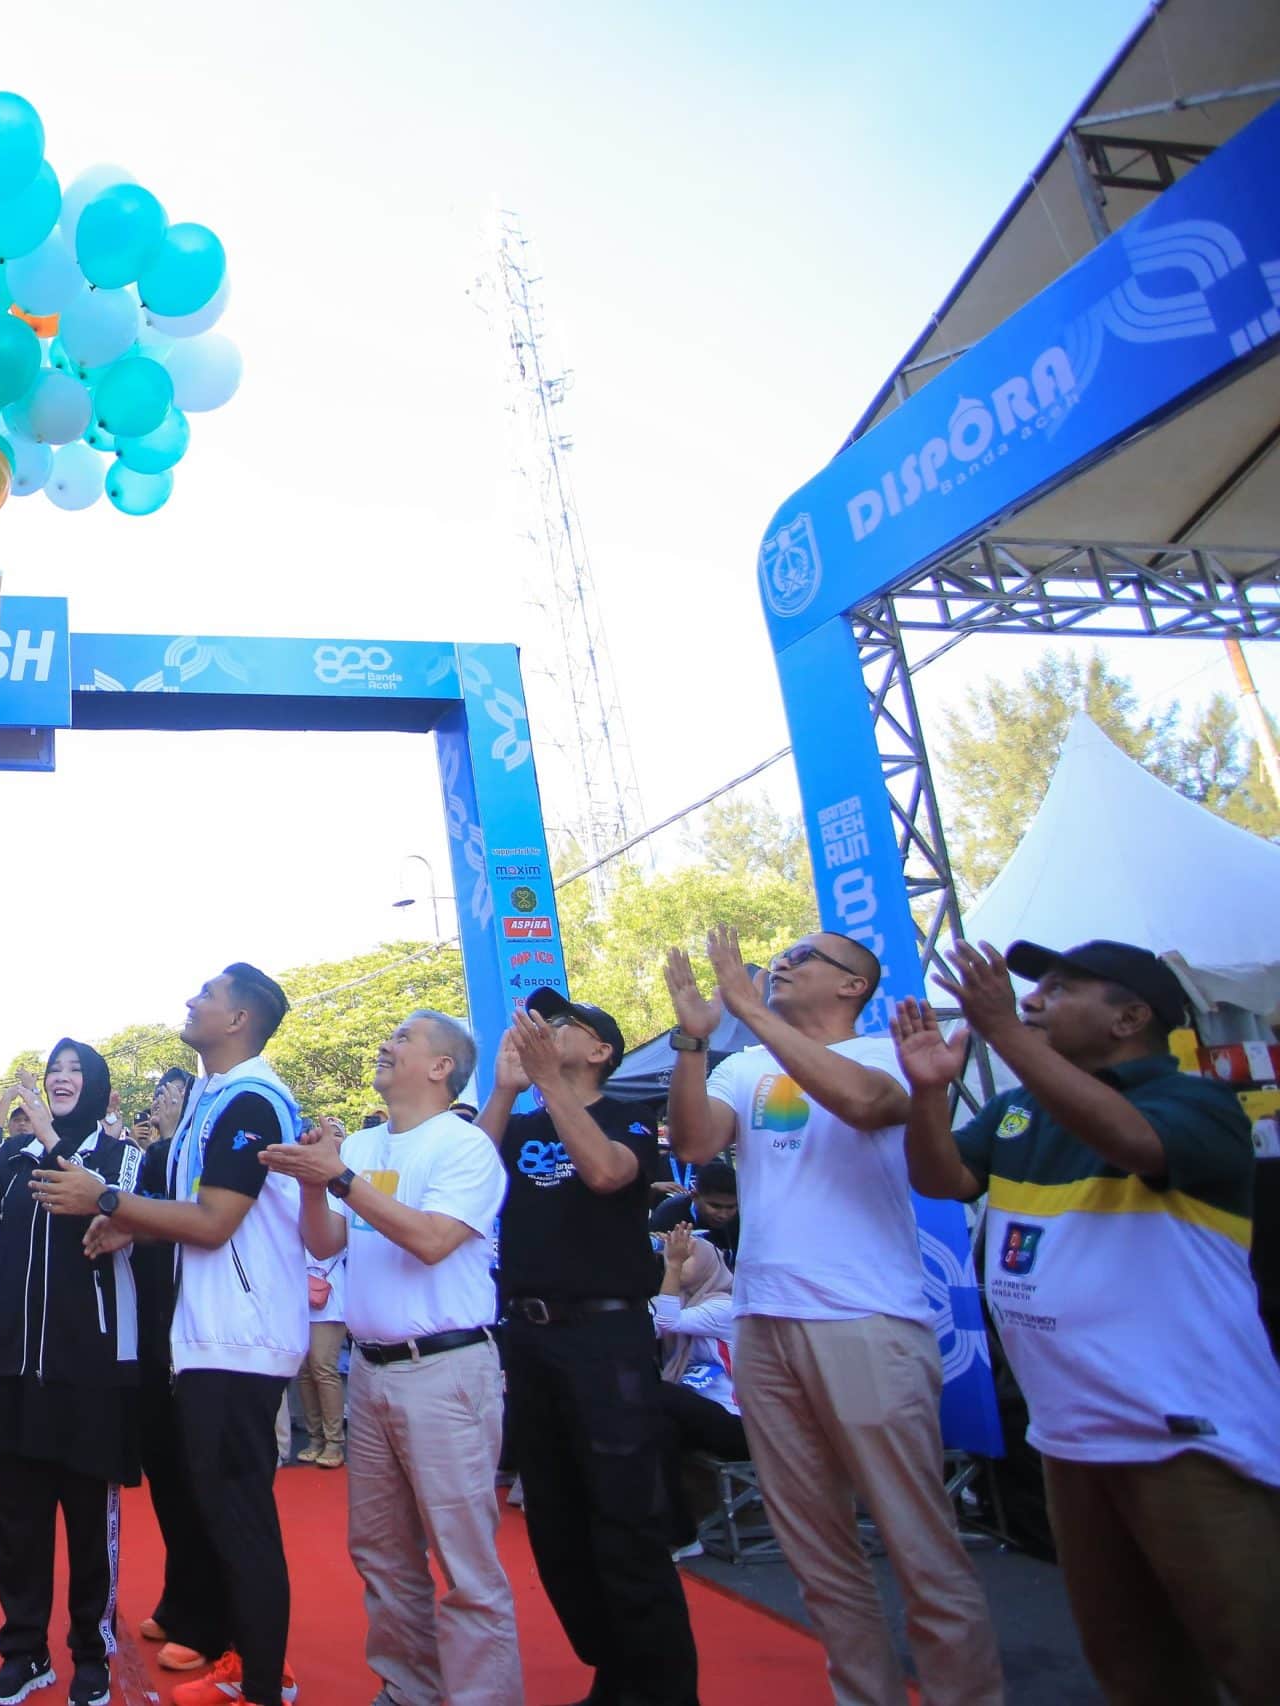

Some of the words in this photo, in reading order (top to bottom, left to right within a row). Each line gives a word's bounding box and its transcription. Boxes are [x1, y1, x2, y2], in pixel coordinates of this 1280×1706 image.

[940, 442, 1009, 496] Banda
[824, 831, 870, 869] RUN
[495, 864, 541, 875] maxim
[524, 978, 561, 986] BRODO
[773, 1139, 787, 1151] by
